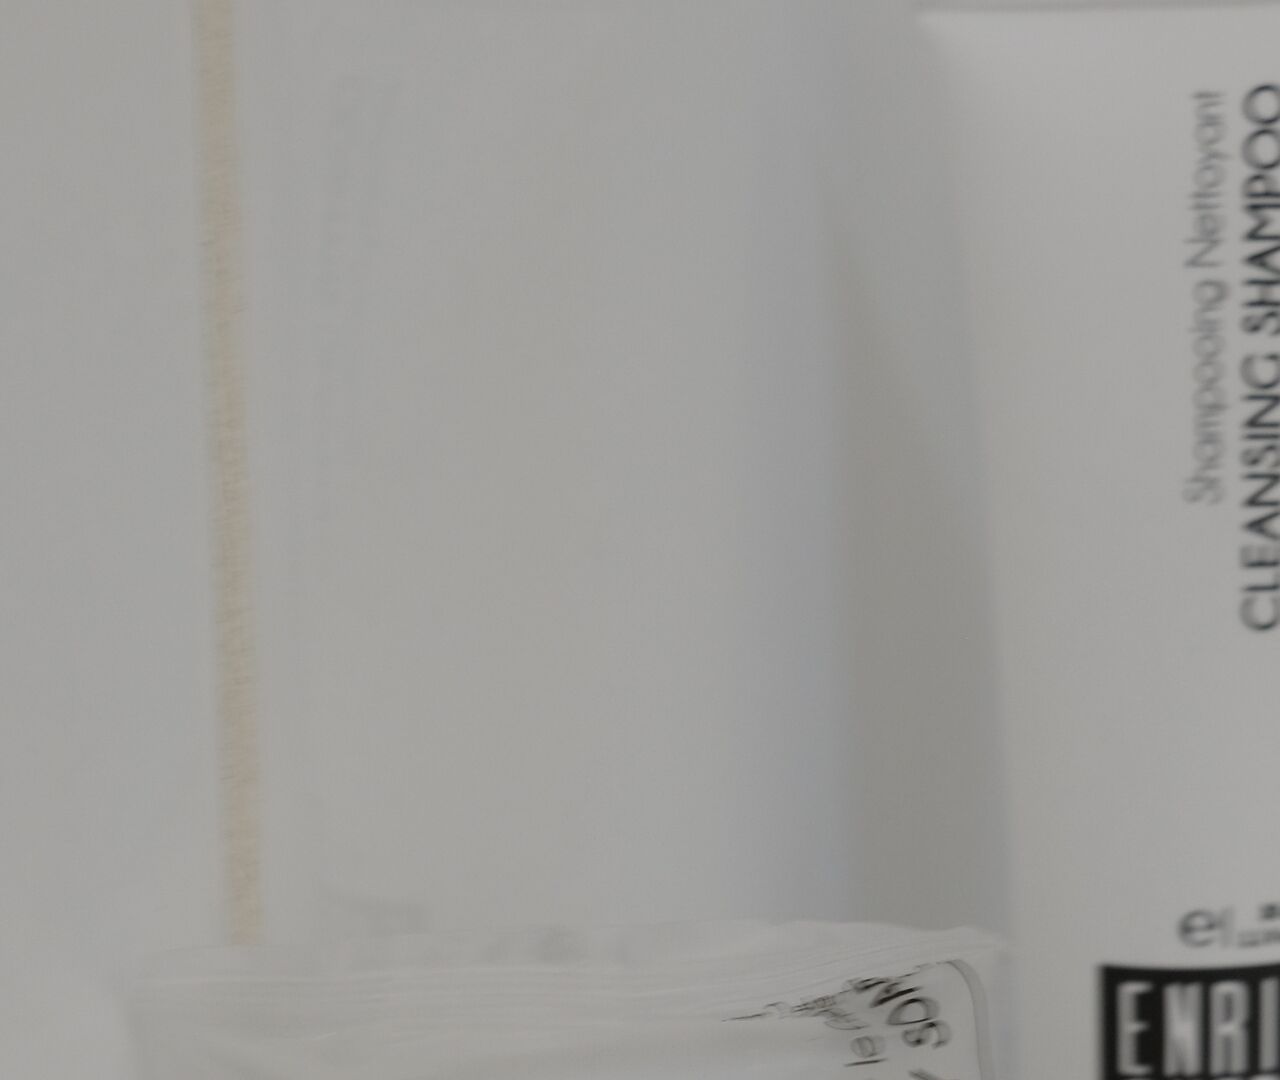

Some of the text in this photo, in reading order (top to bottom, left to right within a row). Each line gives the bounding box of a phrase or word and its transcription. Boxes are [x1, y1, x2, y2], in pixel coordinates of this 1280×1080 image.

[1184, 91, 1231, 503] Shampooing Nettoyant
[1115, 976, 1280, 1077] ENRI
